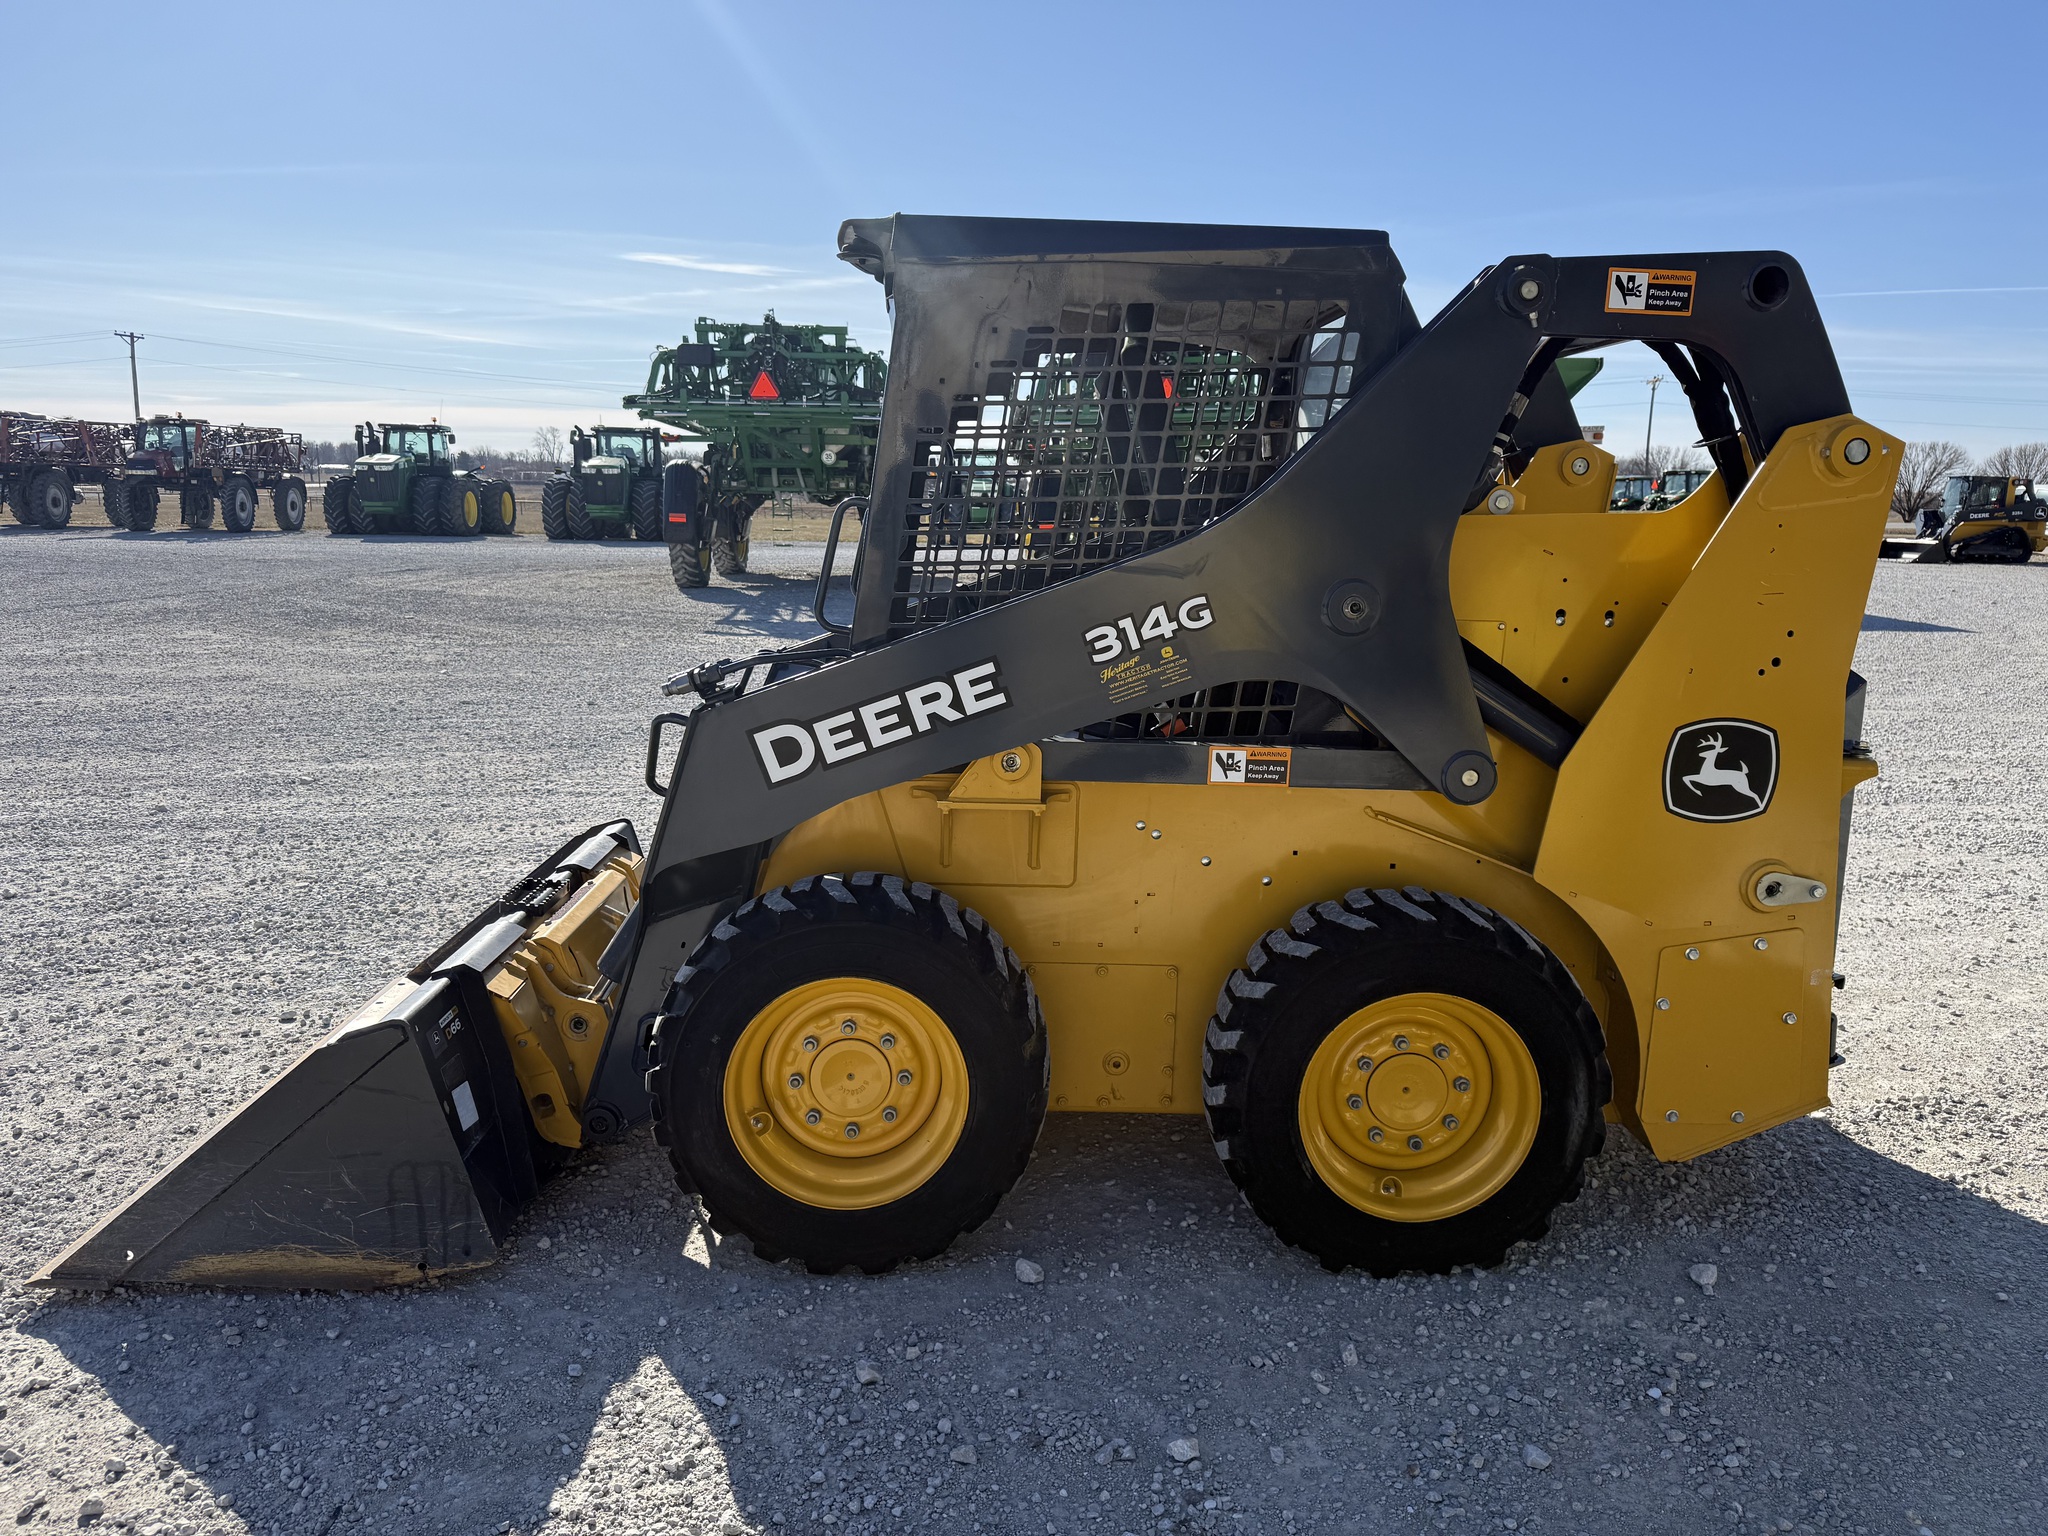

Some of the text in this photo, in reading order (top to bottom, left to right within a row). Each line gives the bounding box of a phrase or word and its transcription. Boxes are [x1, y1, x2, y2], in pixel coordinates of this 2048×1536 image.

[1648, 298, 1682, 307] Keep Away
[1649, 289, 1670, 297] Pinch
[1085, 596, 1213, 663] 314G
[1100, 655, 1140, 684] Heritage
[1109, 658, 1188, 689] WWW.HERITAGETRACTOR.COM
[1116, 664, 1152, 680] TRACTOR
[753, 662, 1007, 783] DEERE
[445, 1018, 462, 1040] D66
